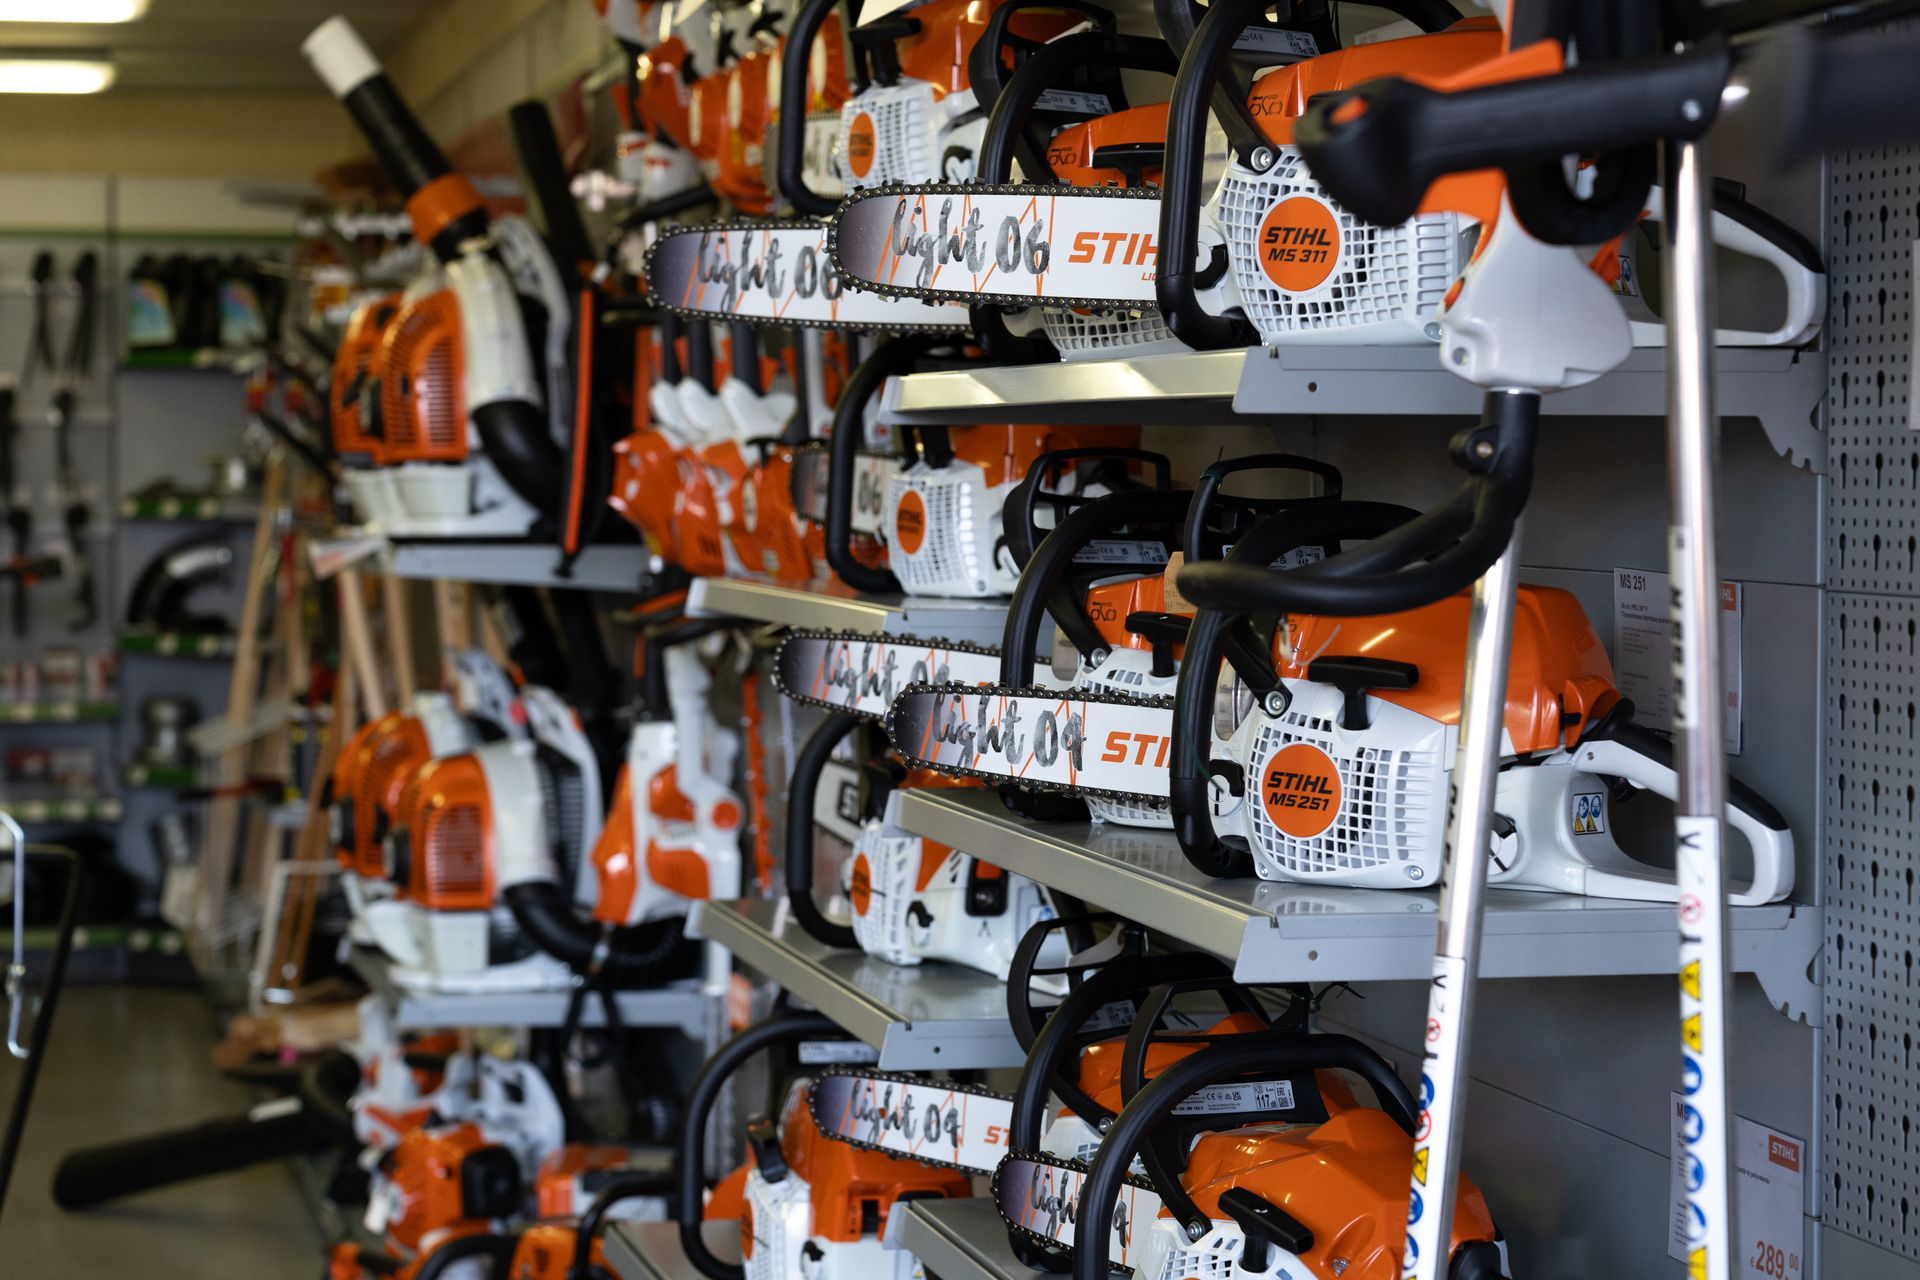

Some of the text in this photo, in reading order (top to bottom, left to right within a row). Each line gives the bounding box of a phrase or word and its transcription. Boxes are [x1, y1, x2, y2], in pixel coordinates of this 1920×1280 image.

[891, 197, 1050, 288] light 06
[1068, 231, 1159, 266] STIH
[1264, 226, 1332, 247] STIHL
[1268, 248, 1328, 264] MS 311
[697, 230, 843, 313] light 06
[1620, 573, 1646, 591] MS 251
[933, 693, 1025, 768] light
[1101, 731, 1170, 769] STI
[1267, 771, 1333, 795] STIHL
[1269, 792, 1329, 811] MS 251
[1772, 1142, 1797, 1162] STIHL
[1030, 1165, 1083, 1239] ligh
